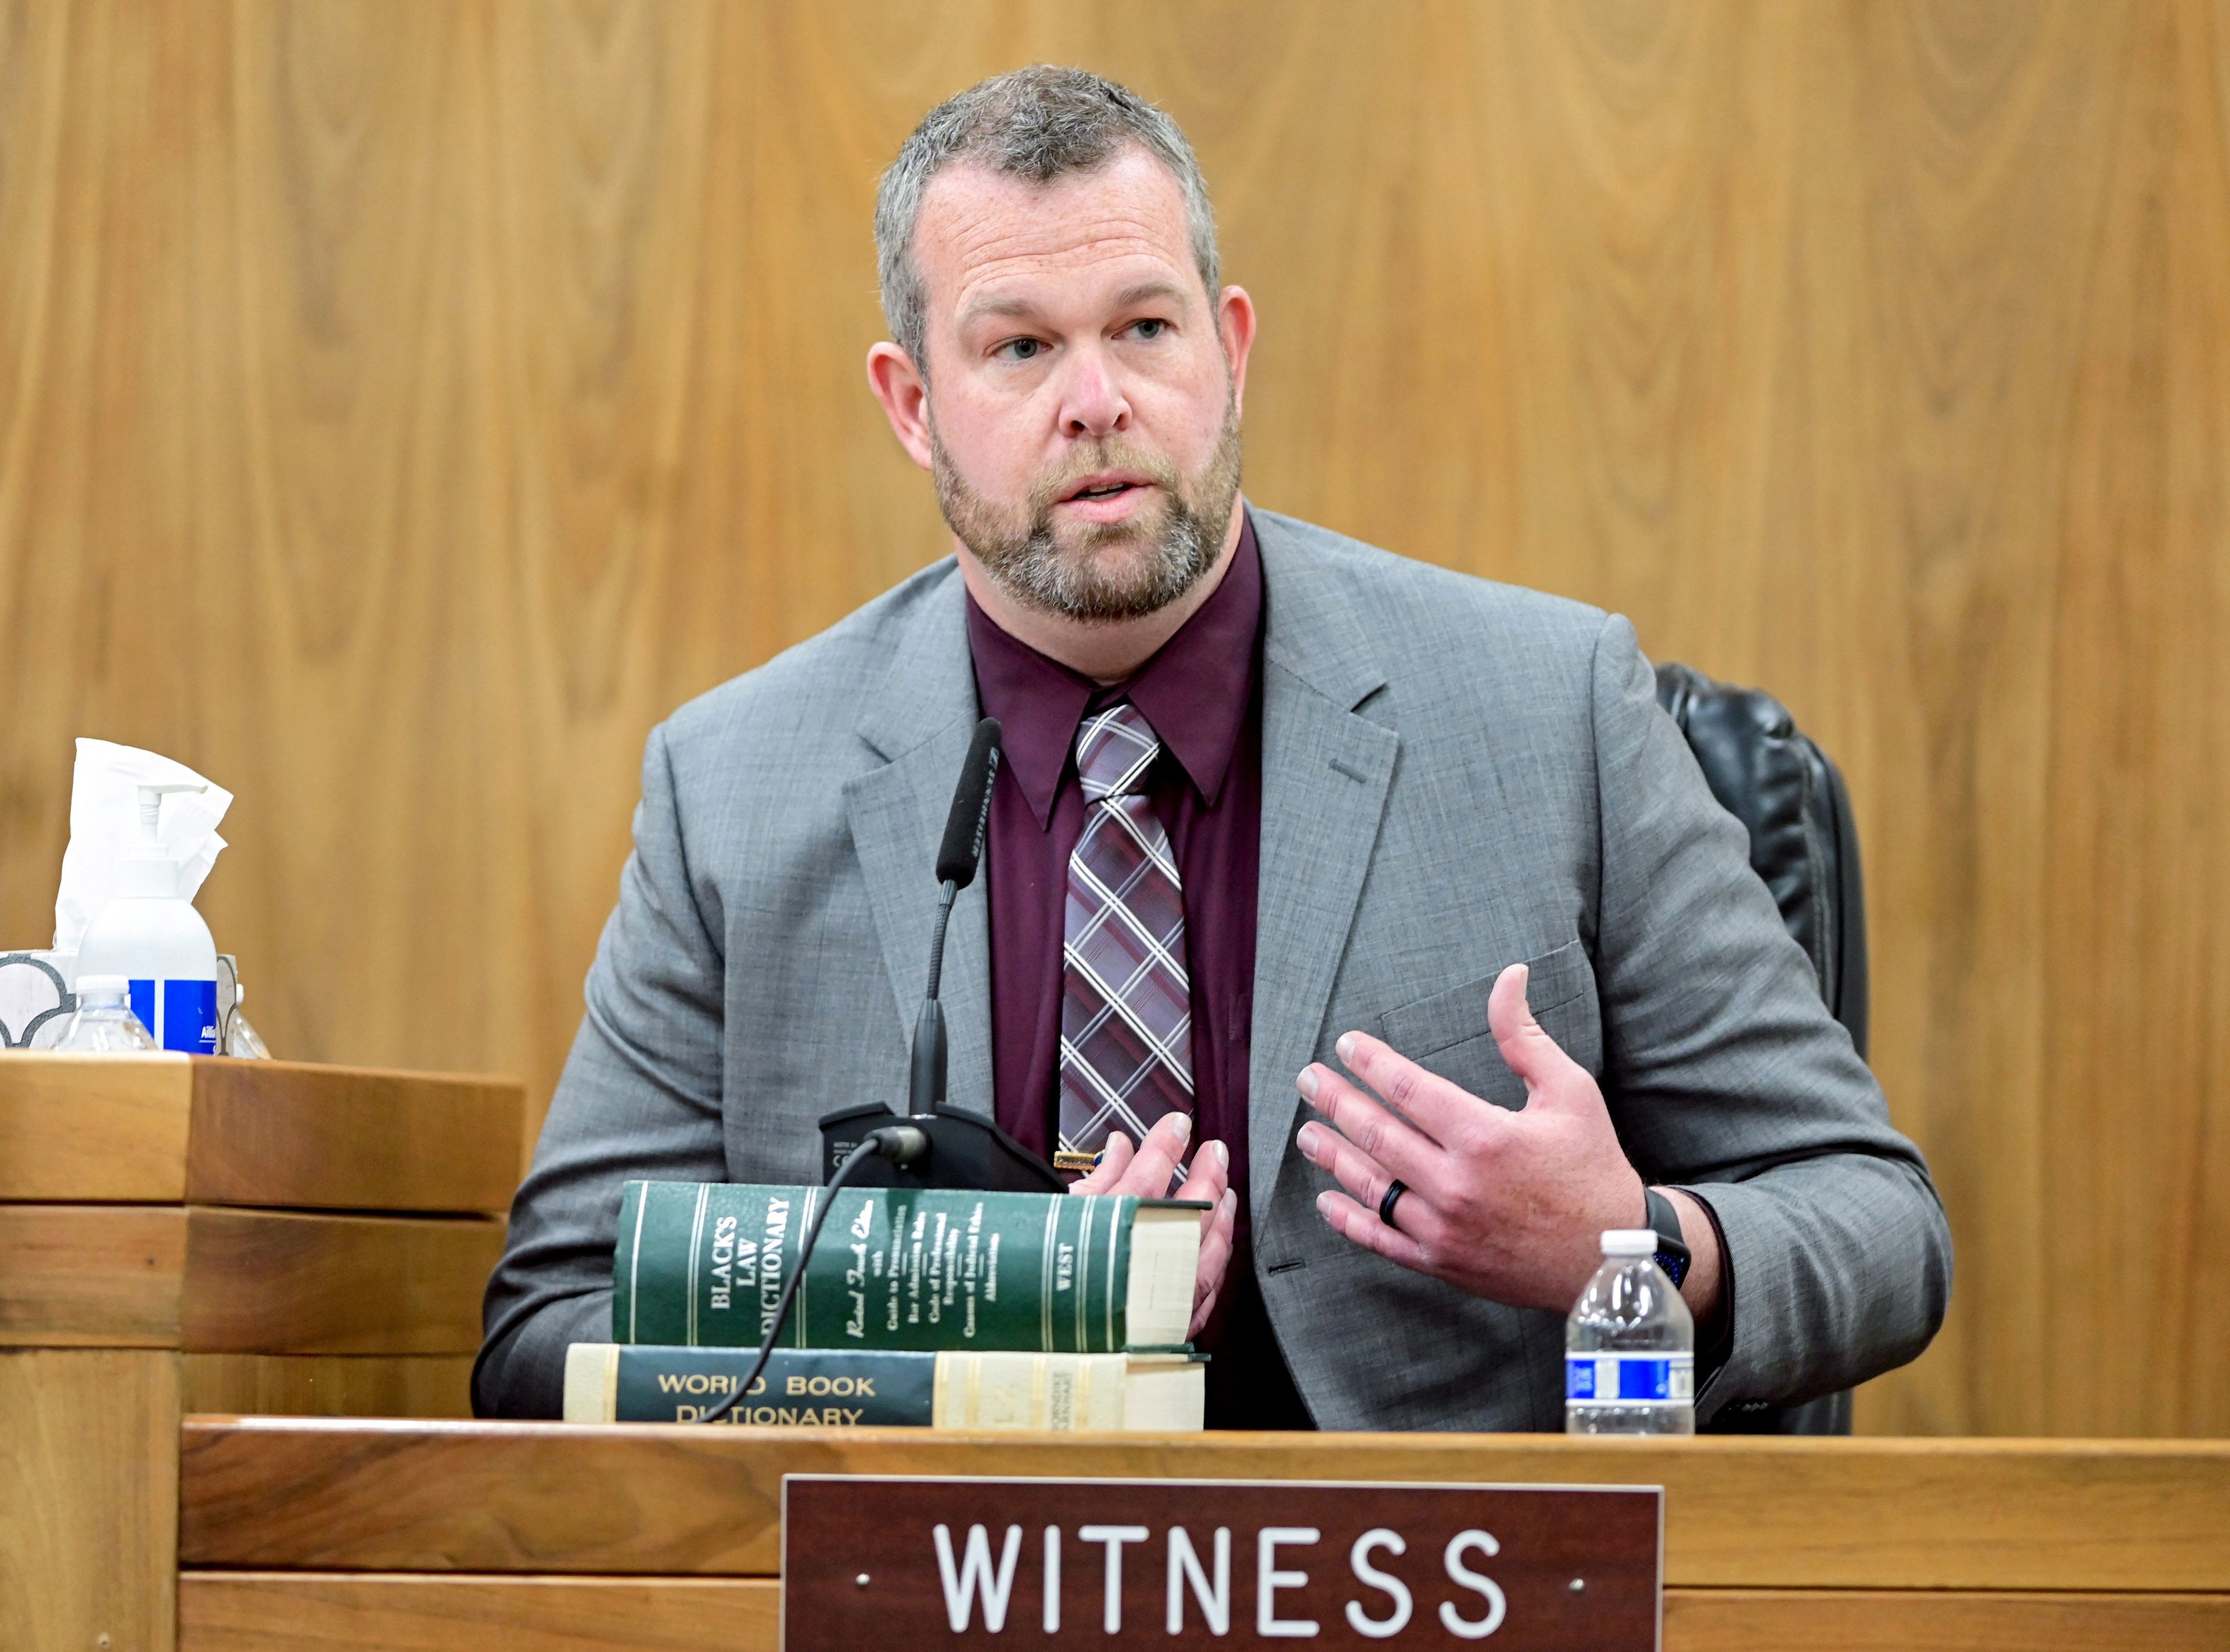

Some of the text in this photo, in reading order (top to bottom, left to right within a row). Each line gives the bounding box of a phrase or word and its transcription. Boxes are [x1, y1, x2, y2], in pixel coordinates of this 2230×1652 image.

[710, 1216, 738, 1310] BLACK'S
[736, 1237, 757, 1287] LAW
[1056, 1242, 1074, 1292] WEST
[888, 1280, 900, 1293] to
[928, 1278, 941, 1291] of
[886, 1296, 899, 1331] Guide
[786, 1376, 877, 1397] BOOK
[931, 1524, 1508, 1640] WITNESS
